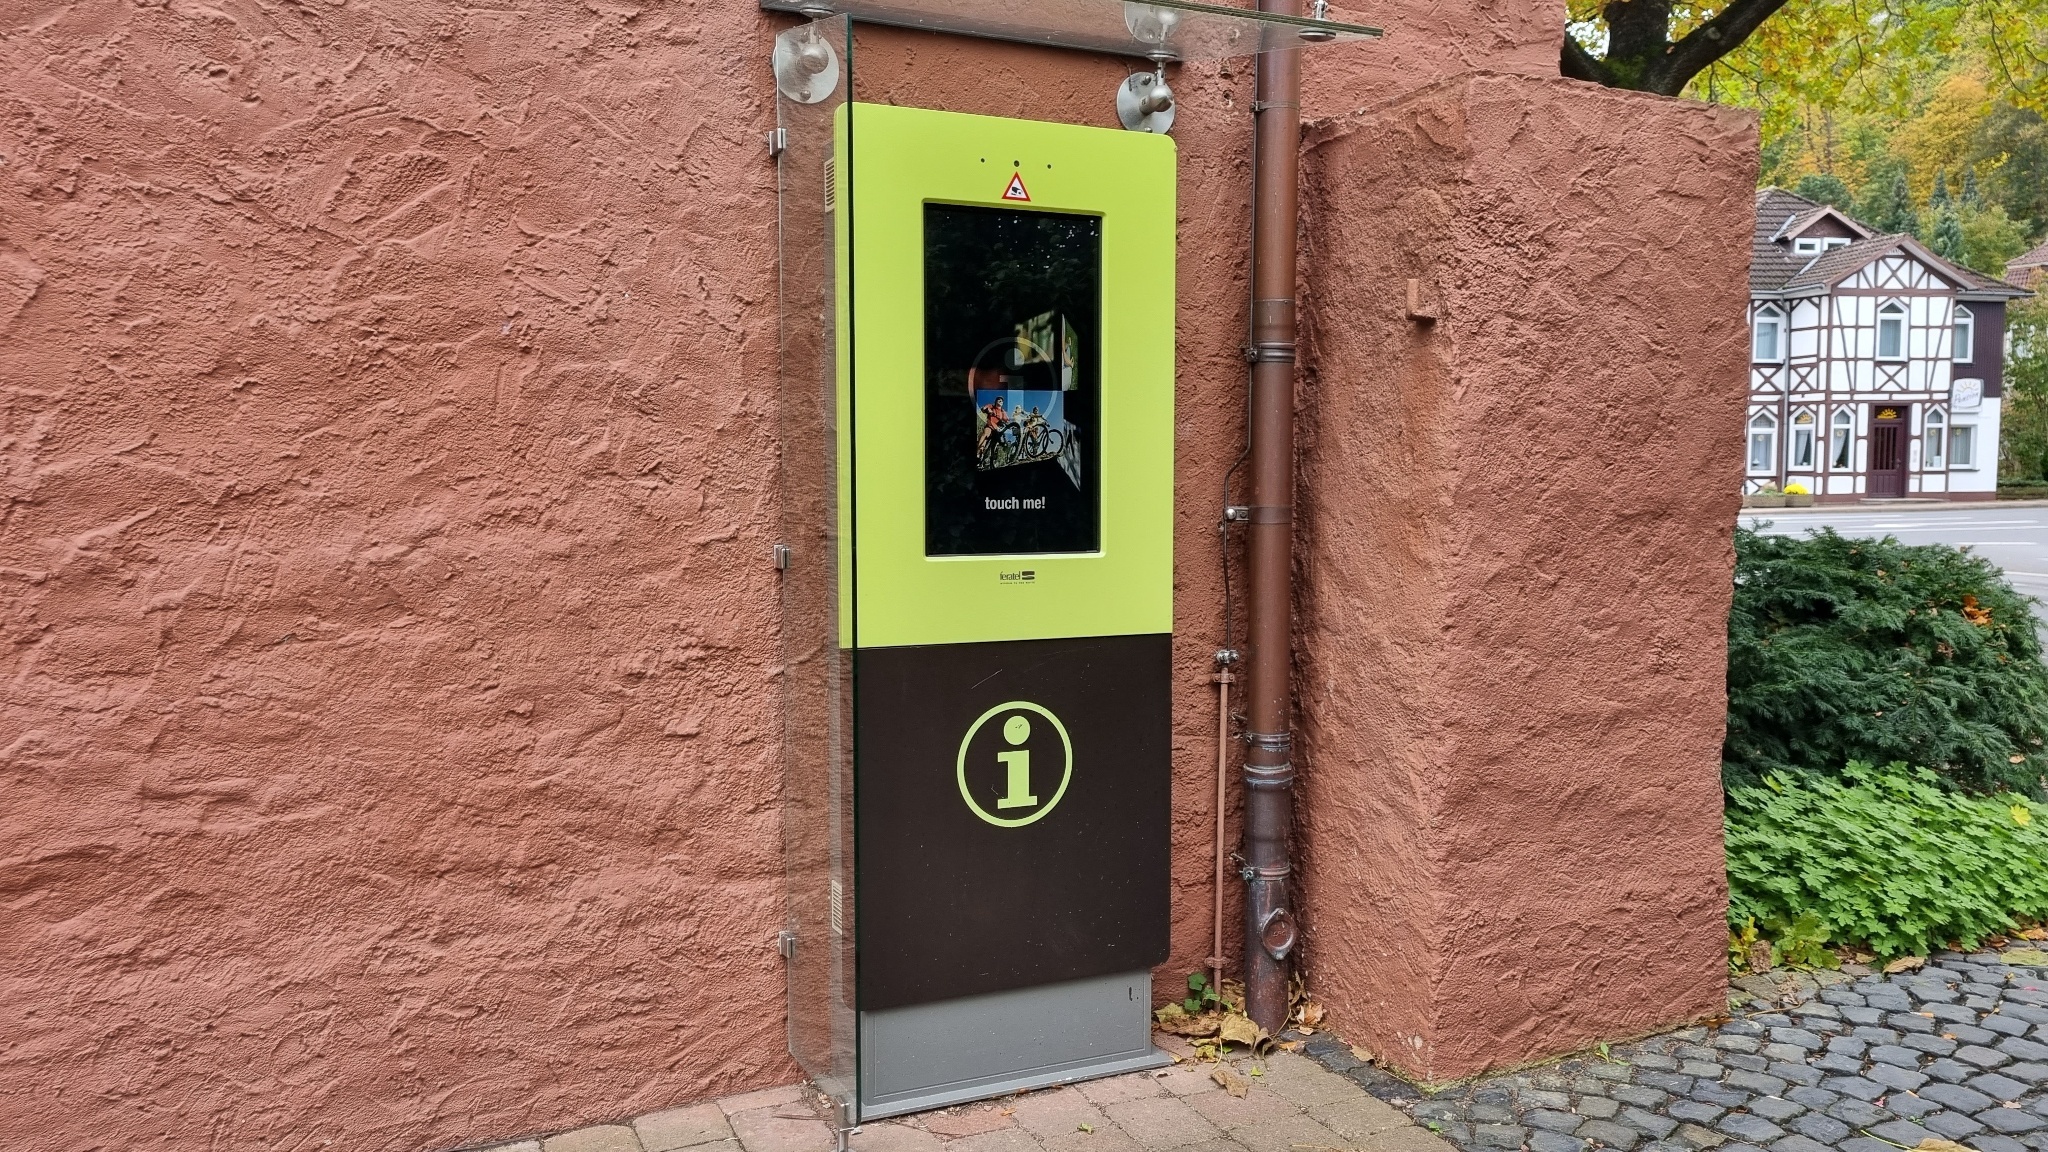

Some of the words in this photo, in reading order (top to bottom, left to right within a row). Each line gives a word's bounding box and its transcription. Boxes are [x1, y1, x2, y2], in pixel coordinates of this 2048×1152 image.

[985, 496, 1020, 510] touch
[1022, 496, 1046, 510] me!
[997, 715, 1038, 809] i
